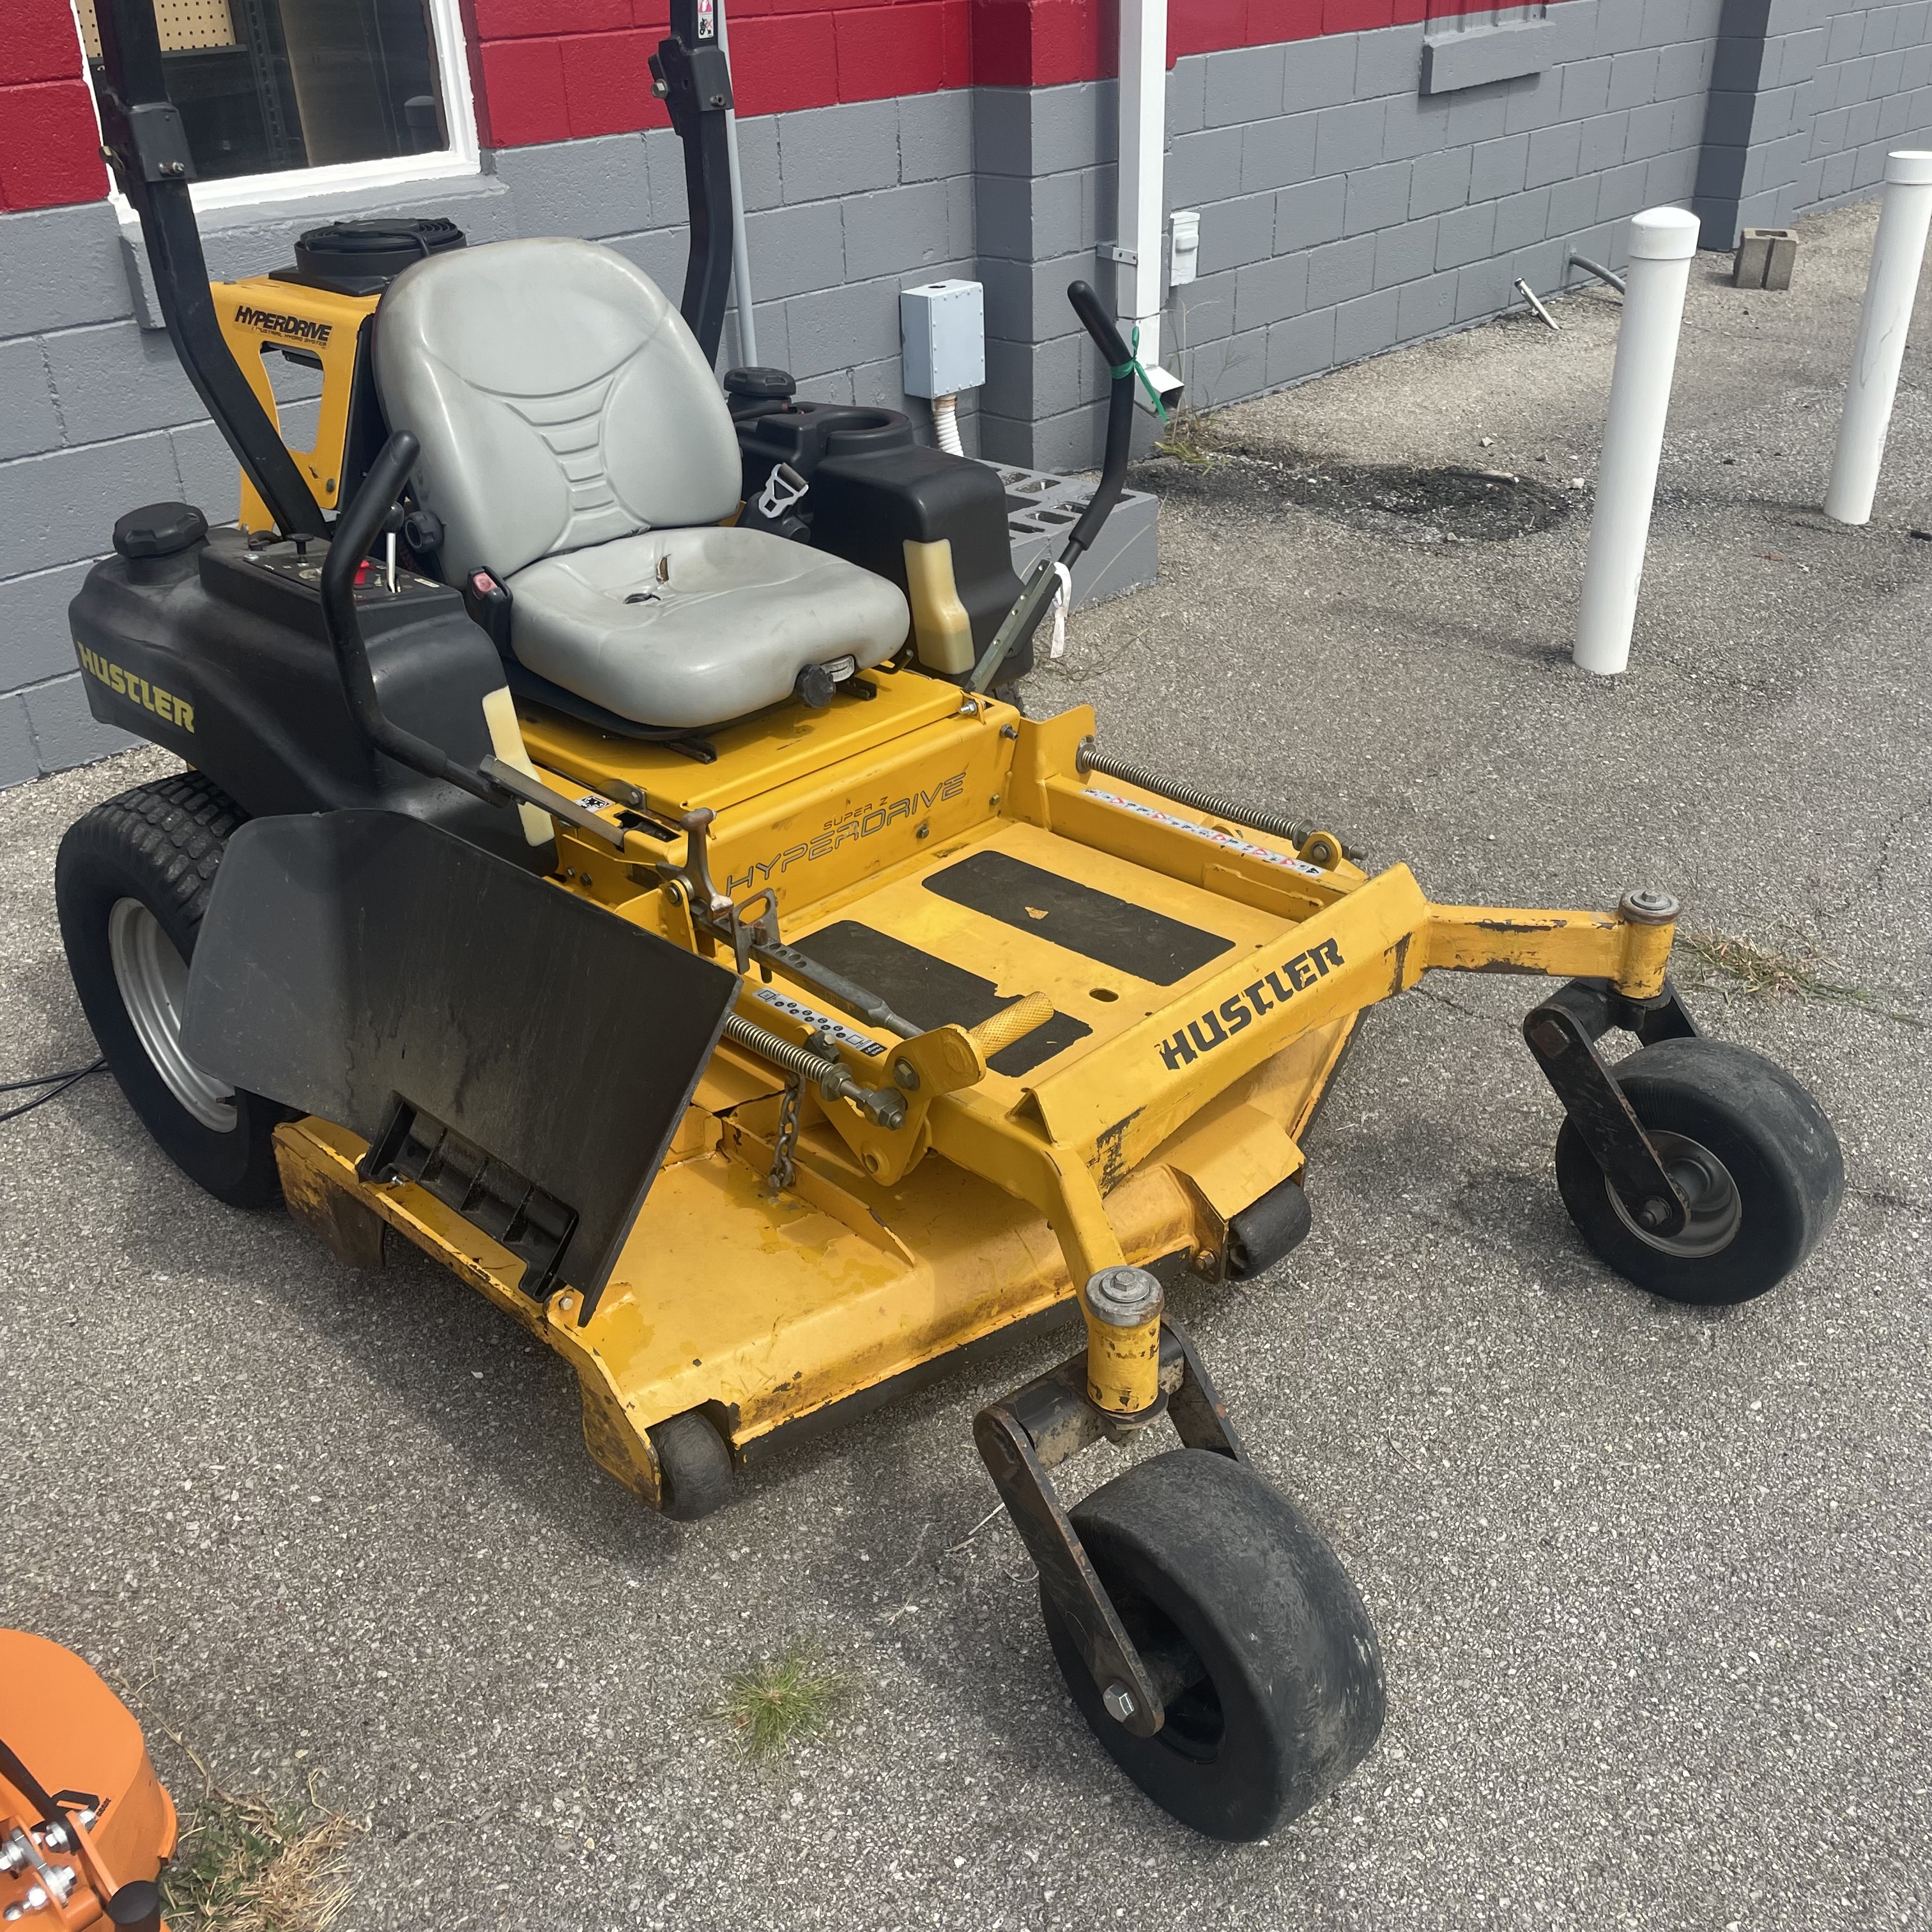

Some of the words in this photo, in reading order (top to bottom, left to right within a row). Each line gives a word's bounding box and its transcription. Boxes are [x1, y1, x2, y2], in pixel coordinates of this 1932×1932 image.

[234, 305, 332, 342] HYPERDRIVE
[77, 641, 195, 733] HUSTLER
[726, 772, 966, 896] HYPERDRIVE
[824, 804, 873, 831] SUPER
[880, 796, 889, 806] Z
[1154, 937, 1346, 1070] HUSTLER
